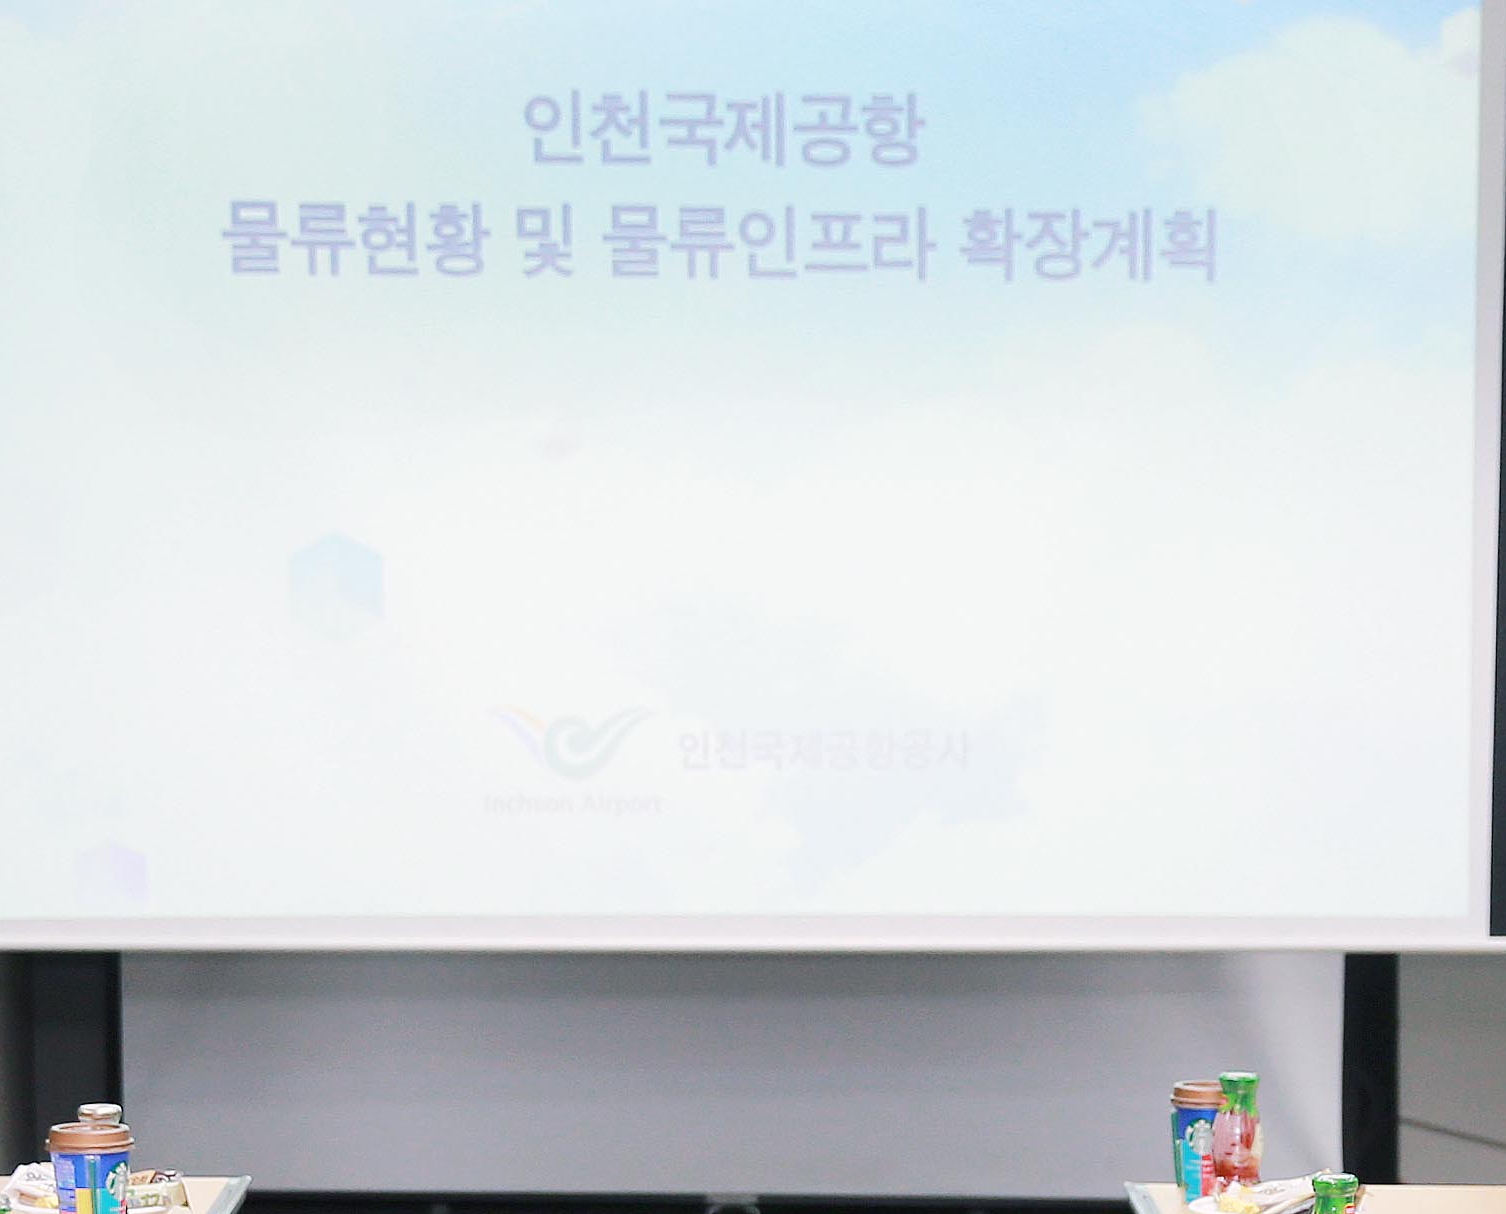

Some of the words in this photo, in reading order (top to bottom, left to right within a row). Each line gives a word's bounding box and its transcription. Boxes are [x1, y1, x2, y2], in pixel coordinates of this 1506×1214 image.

[523, 89, 926, 168] 인천국제공항
[222, 200, 491, 277] 물류현황
[516, 203, 574, 278] 및
[602, 203, 937, 281] 물류인프라
[959, 206, 1218, 283] 확장계획
